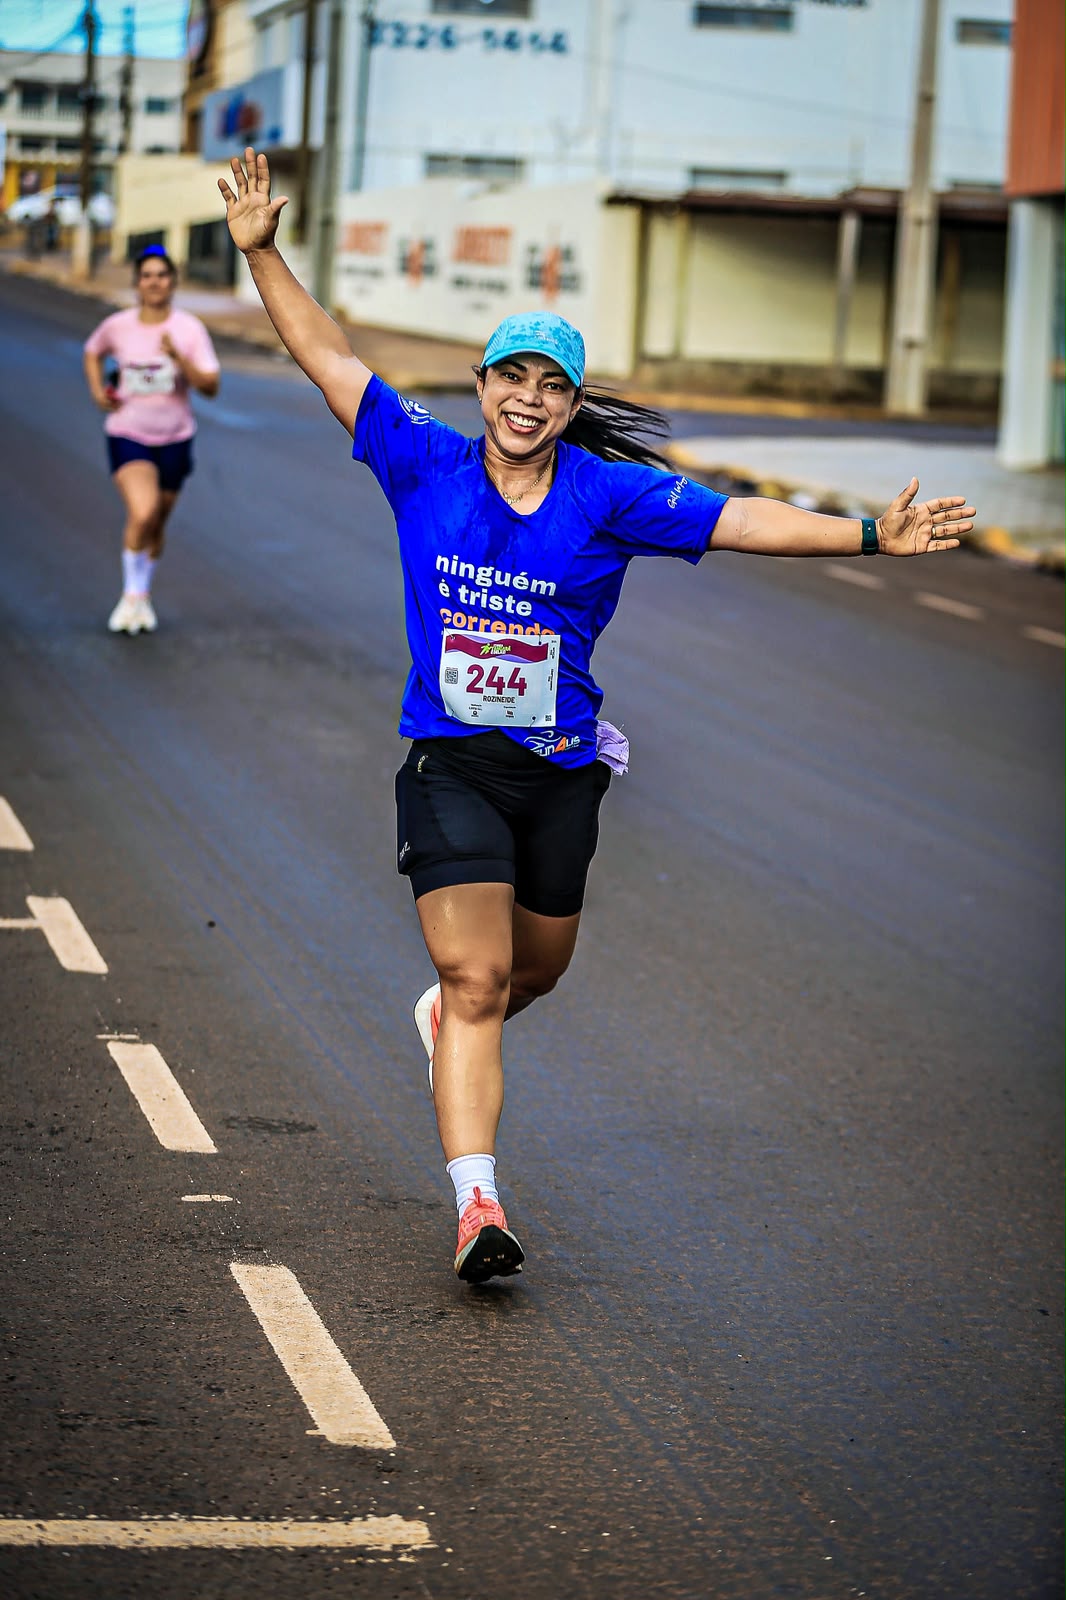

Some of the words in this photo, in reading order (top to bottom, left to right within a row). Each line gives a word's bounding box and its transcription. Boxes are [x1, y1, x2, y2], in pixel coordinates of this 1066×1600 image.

[435, 554, 557, 597] ninguém
[458, 584, 533, 617] triste
[466, 664, 528, 697] 244
[482, 695, 516, 704] ROZINEIDE
